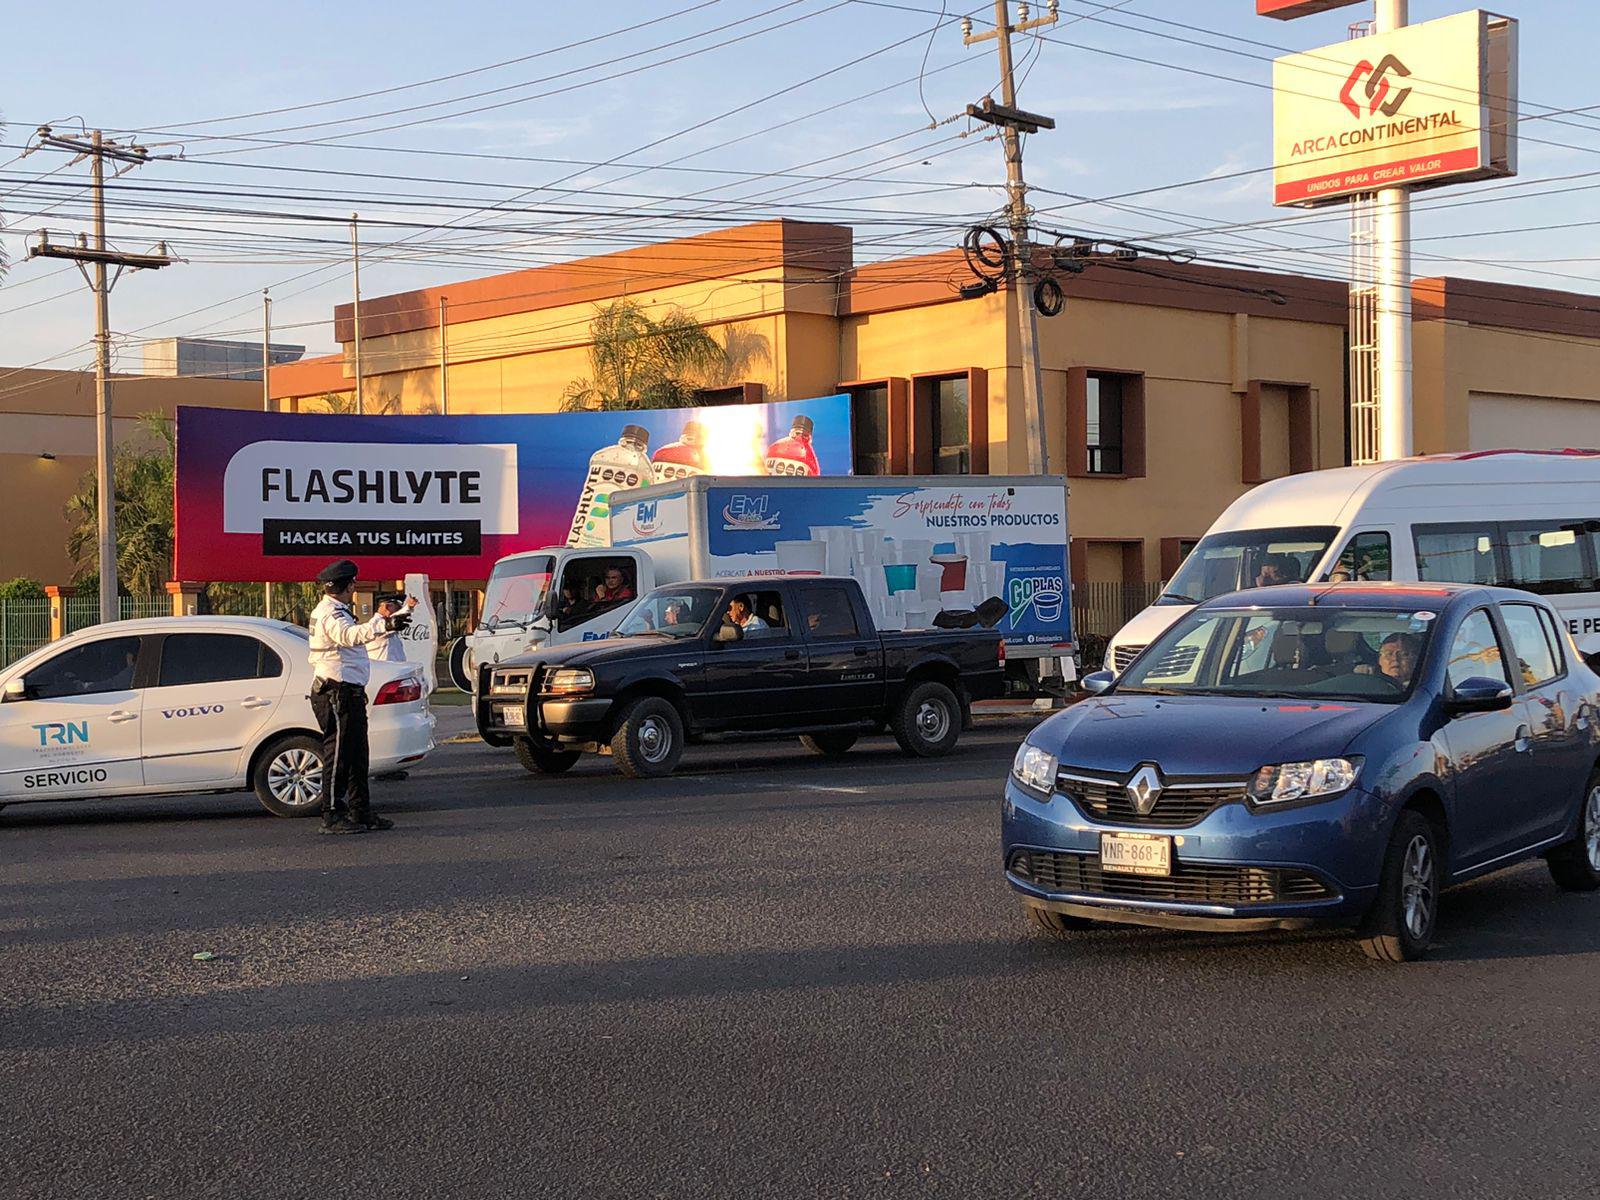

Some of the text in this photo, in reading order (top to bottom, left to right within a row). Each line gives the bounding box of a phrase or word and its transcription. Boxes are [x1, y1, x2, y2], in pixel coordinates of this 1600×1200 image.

[1307, 159, 1441, 193] UNIDOS PARA CREAR VALOR
[262, 468, 481, 503] FLASHLYTE
[637, 501, 657, 523] EMI
[730, 495, 768, 515] EMI
[969, 500, 984, 509] con
[988, 492, 1012, 516] todos
[926, 513, 1059, 527] NUESTROS PRODUCTOS
[280, 529, 463, 545] HACKEA TUS LÍMITES
[747, 569, 753, 577] A
[754, 569, 786, 577] NUESTRO
[1563, 619, 1578, 635] E
[161, 704, 224, 718] VOLVO
[32, 721, 88, 745] TRN
[24, 768, 107, 788] SERVICIO
[1103, 842, 1167, 863] VNR-868-A
